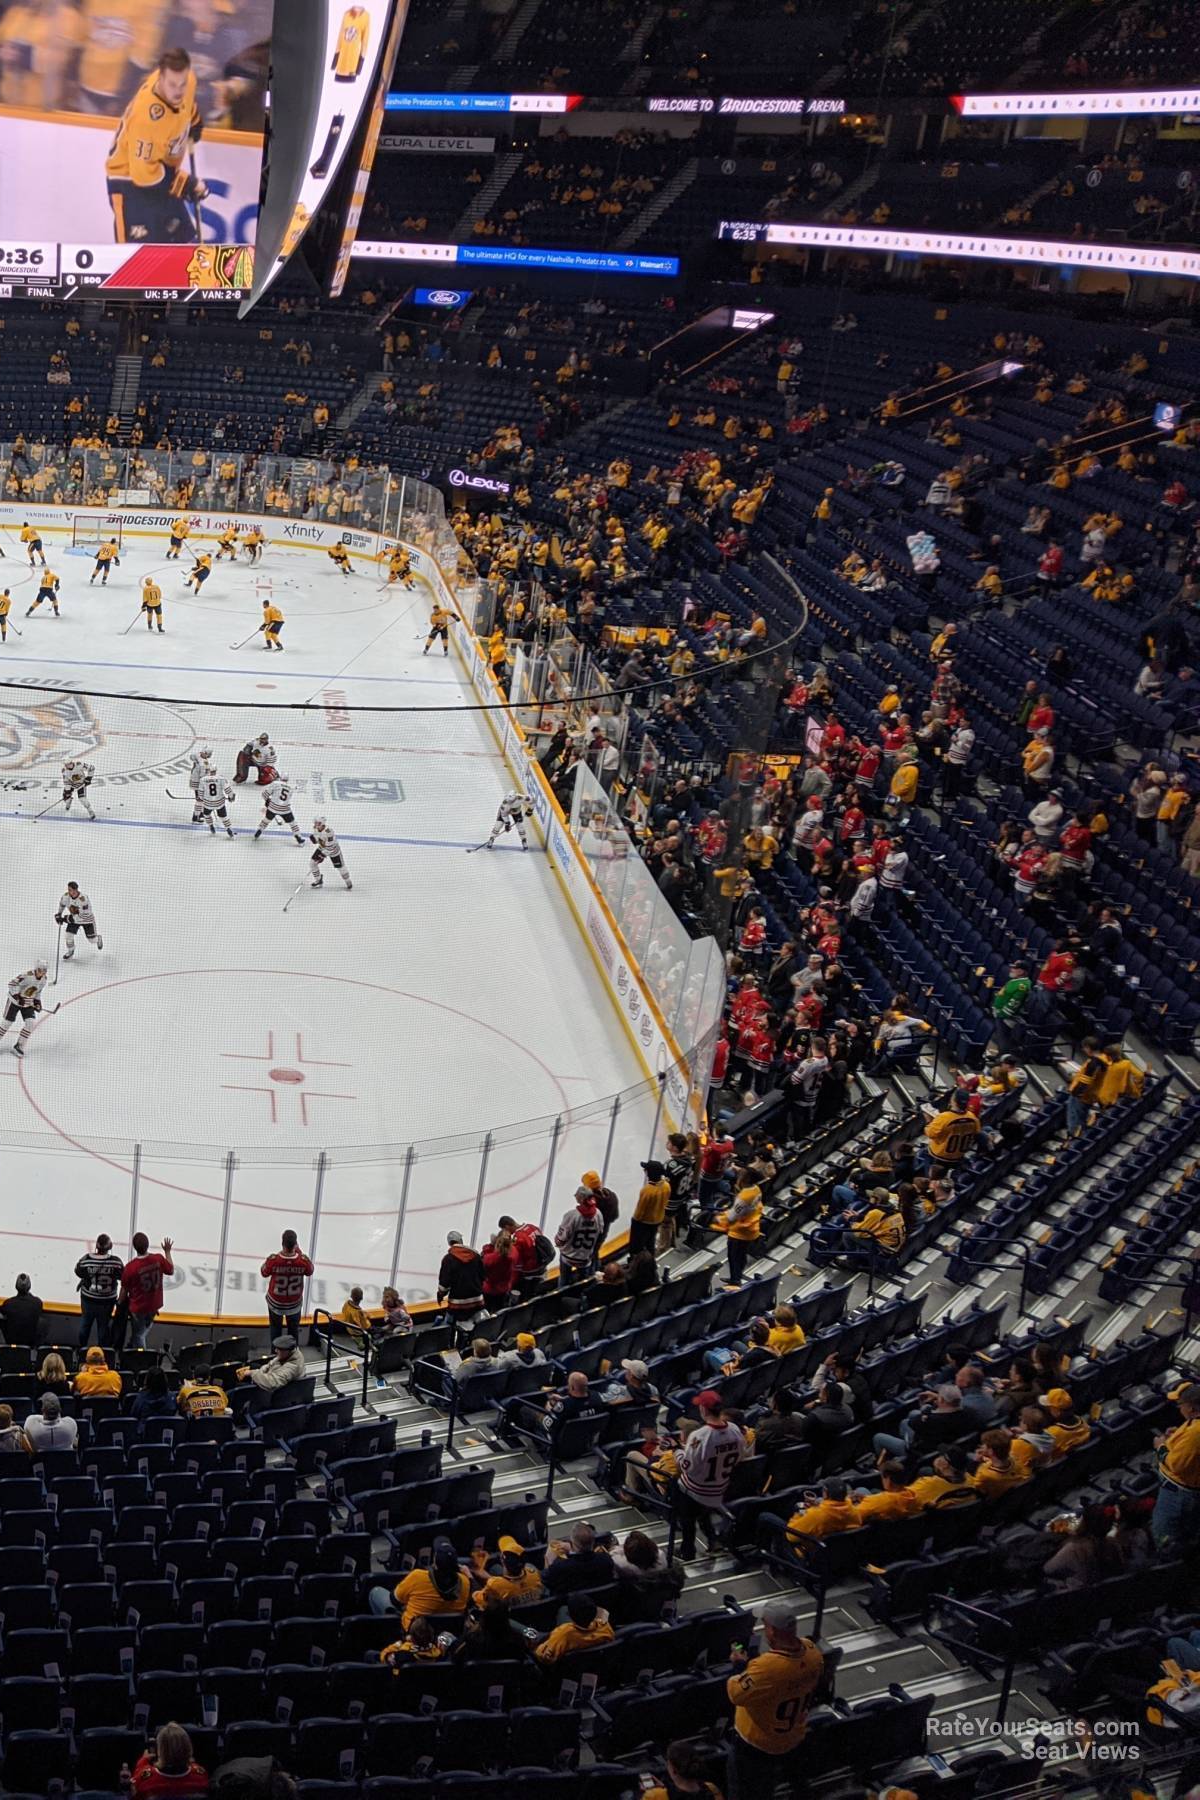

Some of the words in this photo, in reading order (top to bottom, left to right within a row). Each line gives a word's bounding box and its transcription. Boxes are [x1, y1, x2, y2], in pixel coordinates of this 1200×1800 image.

[649, 98, 699, 112] WELCOME
[700, 99, 714, 112] TO
[719, 97, 803, 113] BRIDGESTONE
[808, 99, 845, 112] ARENA
[428, 139, 474, 150] LEVEL
[732, 230, 756, 240] 6:35
[75, 249, 94, 269] 0
[463, 249, 475, 259] The
[476, 250, 502, 261] ultimate
[504, 252, 516, 261] HQ
[517, 252, 528, 261] for
[529, 254, 546, 264] every
[547, 254, 574, 264] Nashville
[575, 256, 606, 265] Predators
[607, 257, 620, 266] fan.
[640, 261, 664, 269] Walmart
[66, 275, 76, 285] 0
[0, 287, 11, 297] 14
[27, 287, 55, 297] FINAL
[145, 291, 161, 299] UK:
[162, 291, 179, 299] 5-5
[202, 291, 224, 299] VAN:
[225, 291, 242, 300] 2-8
[465, 475, 510, 492] LEXUS
[26, 511, 63, 519] VANDERBILT
[283, 522, 325, 542] xfinity
[149, 590, 159, 600] 13
[209, 783, 217, 796] 8
[279, 787, 289, 801] 5
[572, 1229, 597, 1250] 65
[272, 1265, 306, 1275] CARPENTER
[191, 1265, 329, 1306] DIEL'S
[274, 1276, 301, 1297] 22
[704, 1452, 740, 1483] 19
